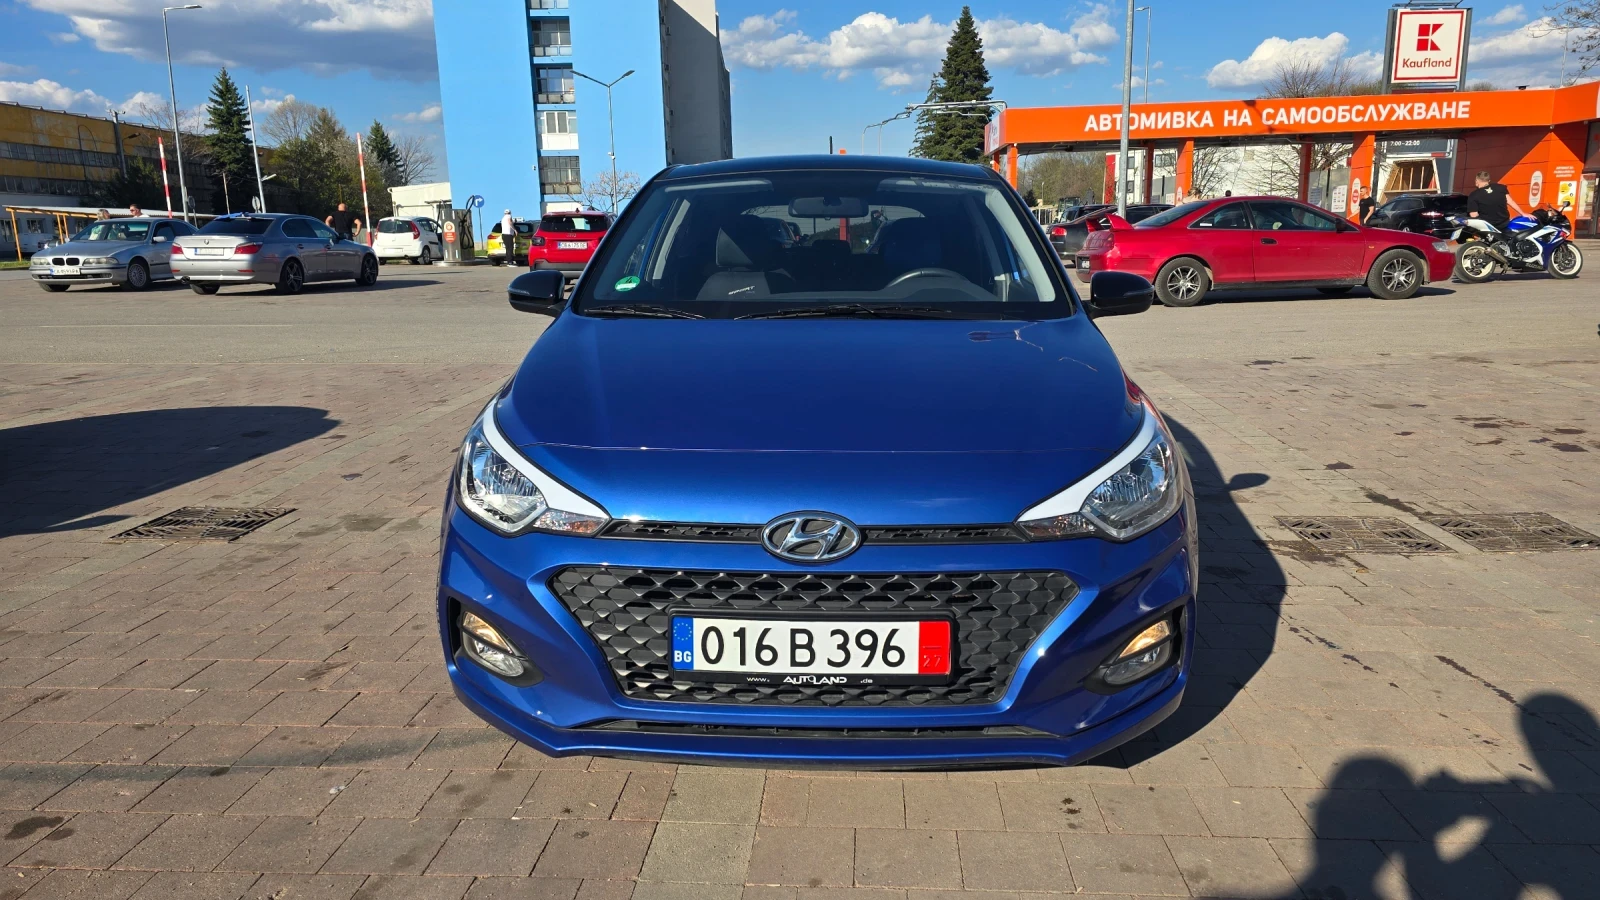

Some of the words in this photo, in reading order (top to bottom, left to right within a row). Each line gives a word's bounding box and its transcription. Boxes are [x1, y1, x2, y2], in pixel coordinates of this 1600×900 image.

[1402, 57, 1453, 69] Kaufland
[1084, 109, 1215, 132] АВТОМИВКА
[1223, 108, 1253, 128] НА
[1261, 100, 1472, 126] САМООБСЛУЖВАНЕ
[700, 625, 778, 667] 016
[789, 628, 816, 668] B
[826, 628, 906, 668] 396
[673, 650, 692, 663] BG
[923, 654, 942, 668] 27
[783, 675, 848, 686] AUTOLAND
